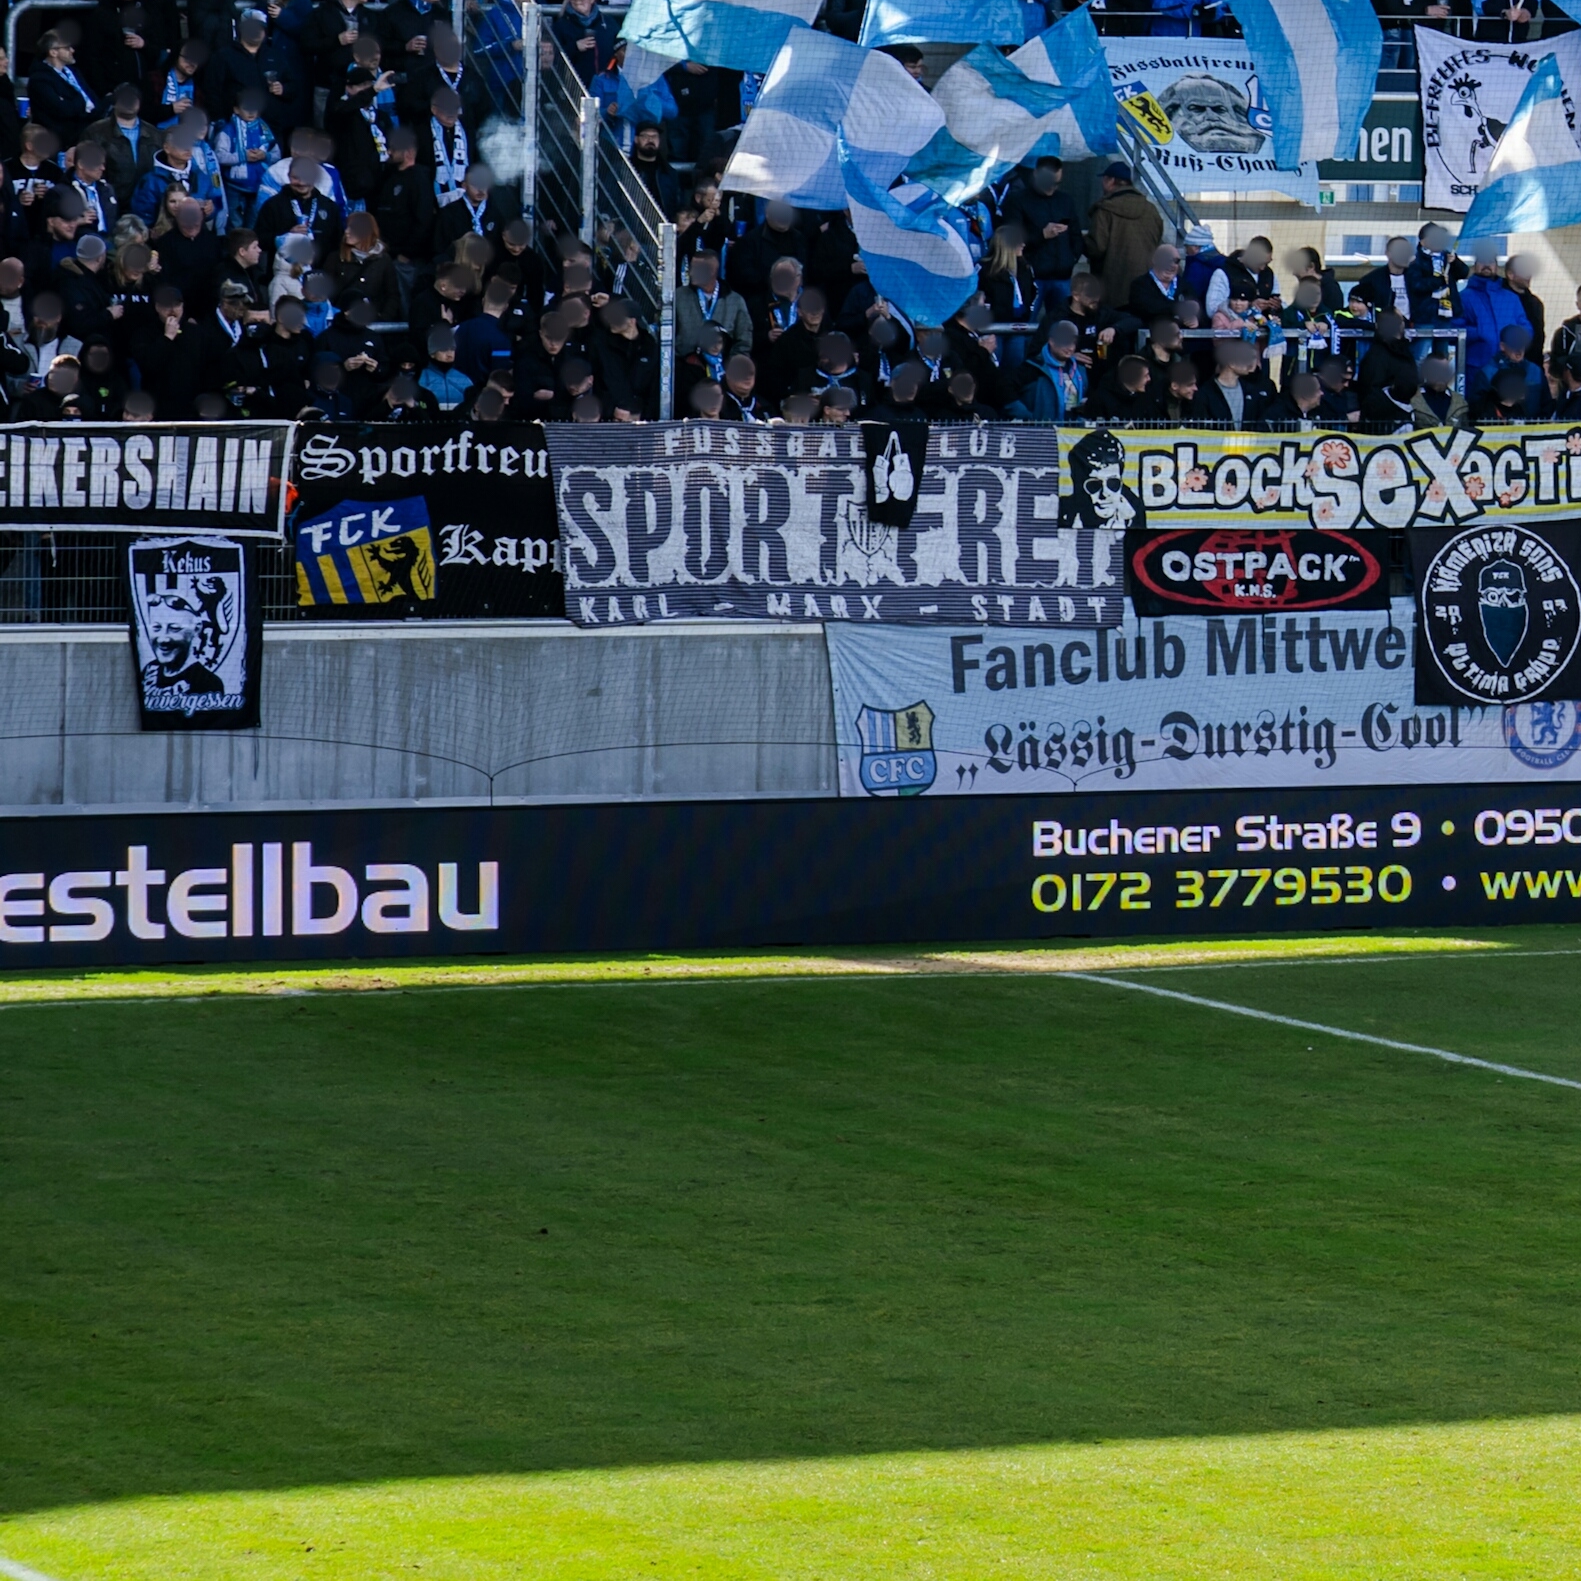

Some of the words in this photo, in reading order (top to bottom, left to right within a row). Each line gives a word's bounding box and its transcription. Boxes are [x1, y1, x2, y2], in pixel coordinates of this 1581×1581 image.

[300, 506, 402, 555] FCK
[949, 620, 1187, 695] Fanclub
[868, 755, 925, 784] CFC
[1032, 818, 1221, 858] Buchener
[1235, 812, 1378, 853] Straße
[1390, 811, 1422, 848] 9
[1030, 871, 1152, 913] 0172
[1174, 864, 1413, 910] 3779530
